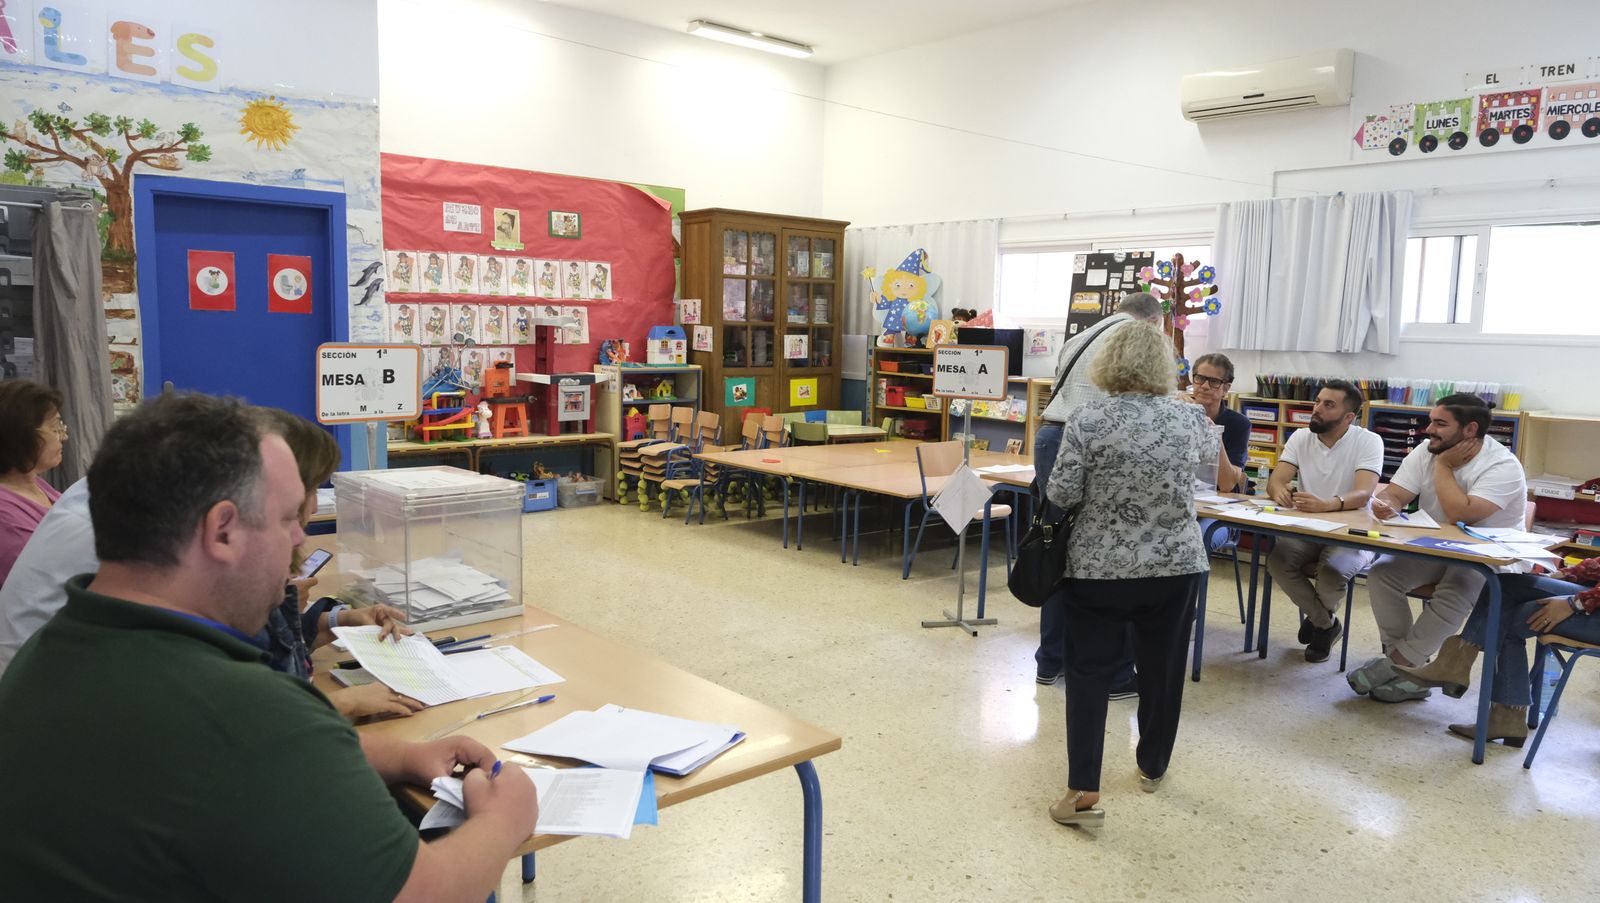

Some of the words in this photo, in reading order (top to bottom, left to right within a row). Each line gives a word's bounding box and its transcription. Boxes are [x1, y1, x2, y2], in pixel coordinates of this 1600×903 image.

[1486, 74, 1499, 84] EL
[1541, 63, 1575, 77] TREN
[1489, 107, 1530, 121] MARTES
[1426, 117, 1459, 130] LUNES
[937, 364, 966, 374] MESA
[978, 364, 988, 374] A
[322, 374, 365, 386] MESA
[383, 368, 395, 384] B
